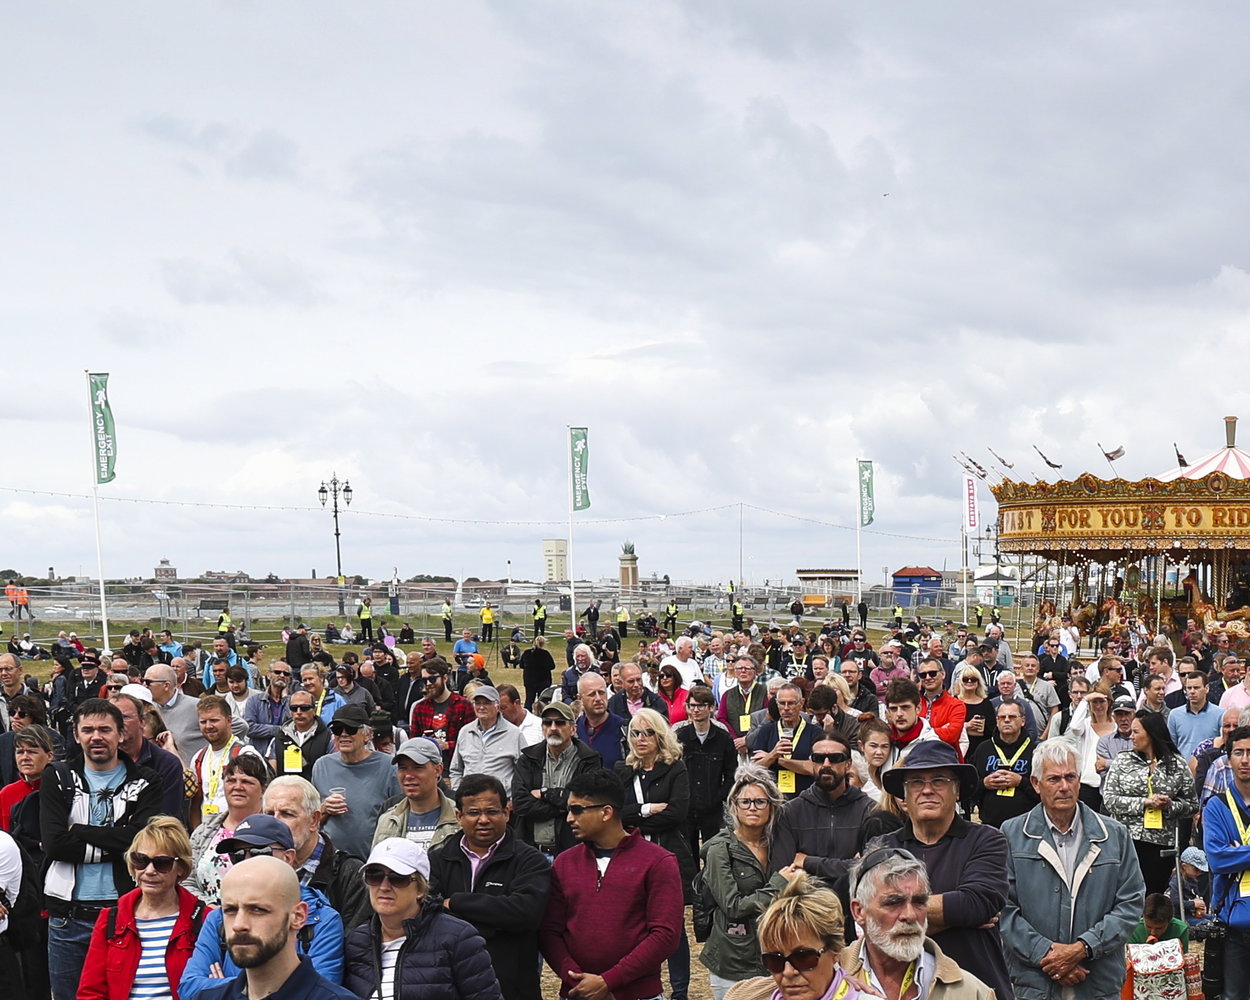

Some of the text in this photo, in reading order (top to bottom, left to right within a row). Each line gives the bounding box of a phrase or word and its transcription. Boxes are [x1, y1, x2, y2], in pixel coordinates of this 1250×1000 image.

[96, 411, 108, 478] EMERGENCY
[105, 433, 113, 456] EXIT
[574, 456, 582, 506] EMERGENCY
[1058, 509, 1091, 529] FOR
[1098, 508, 1140, 529] YOU
[1171, 508, 1202, 527] TO
